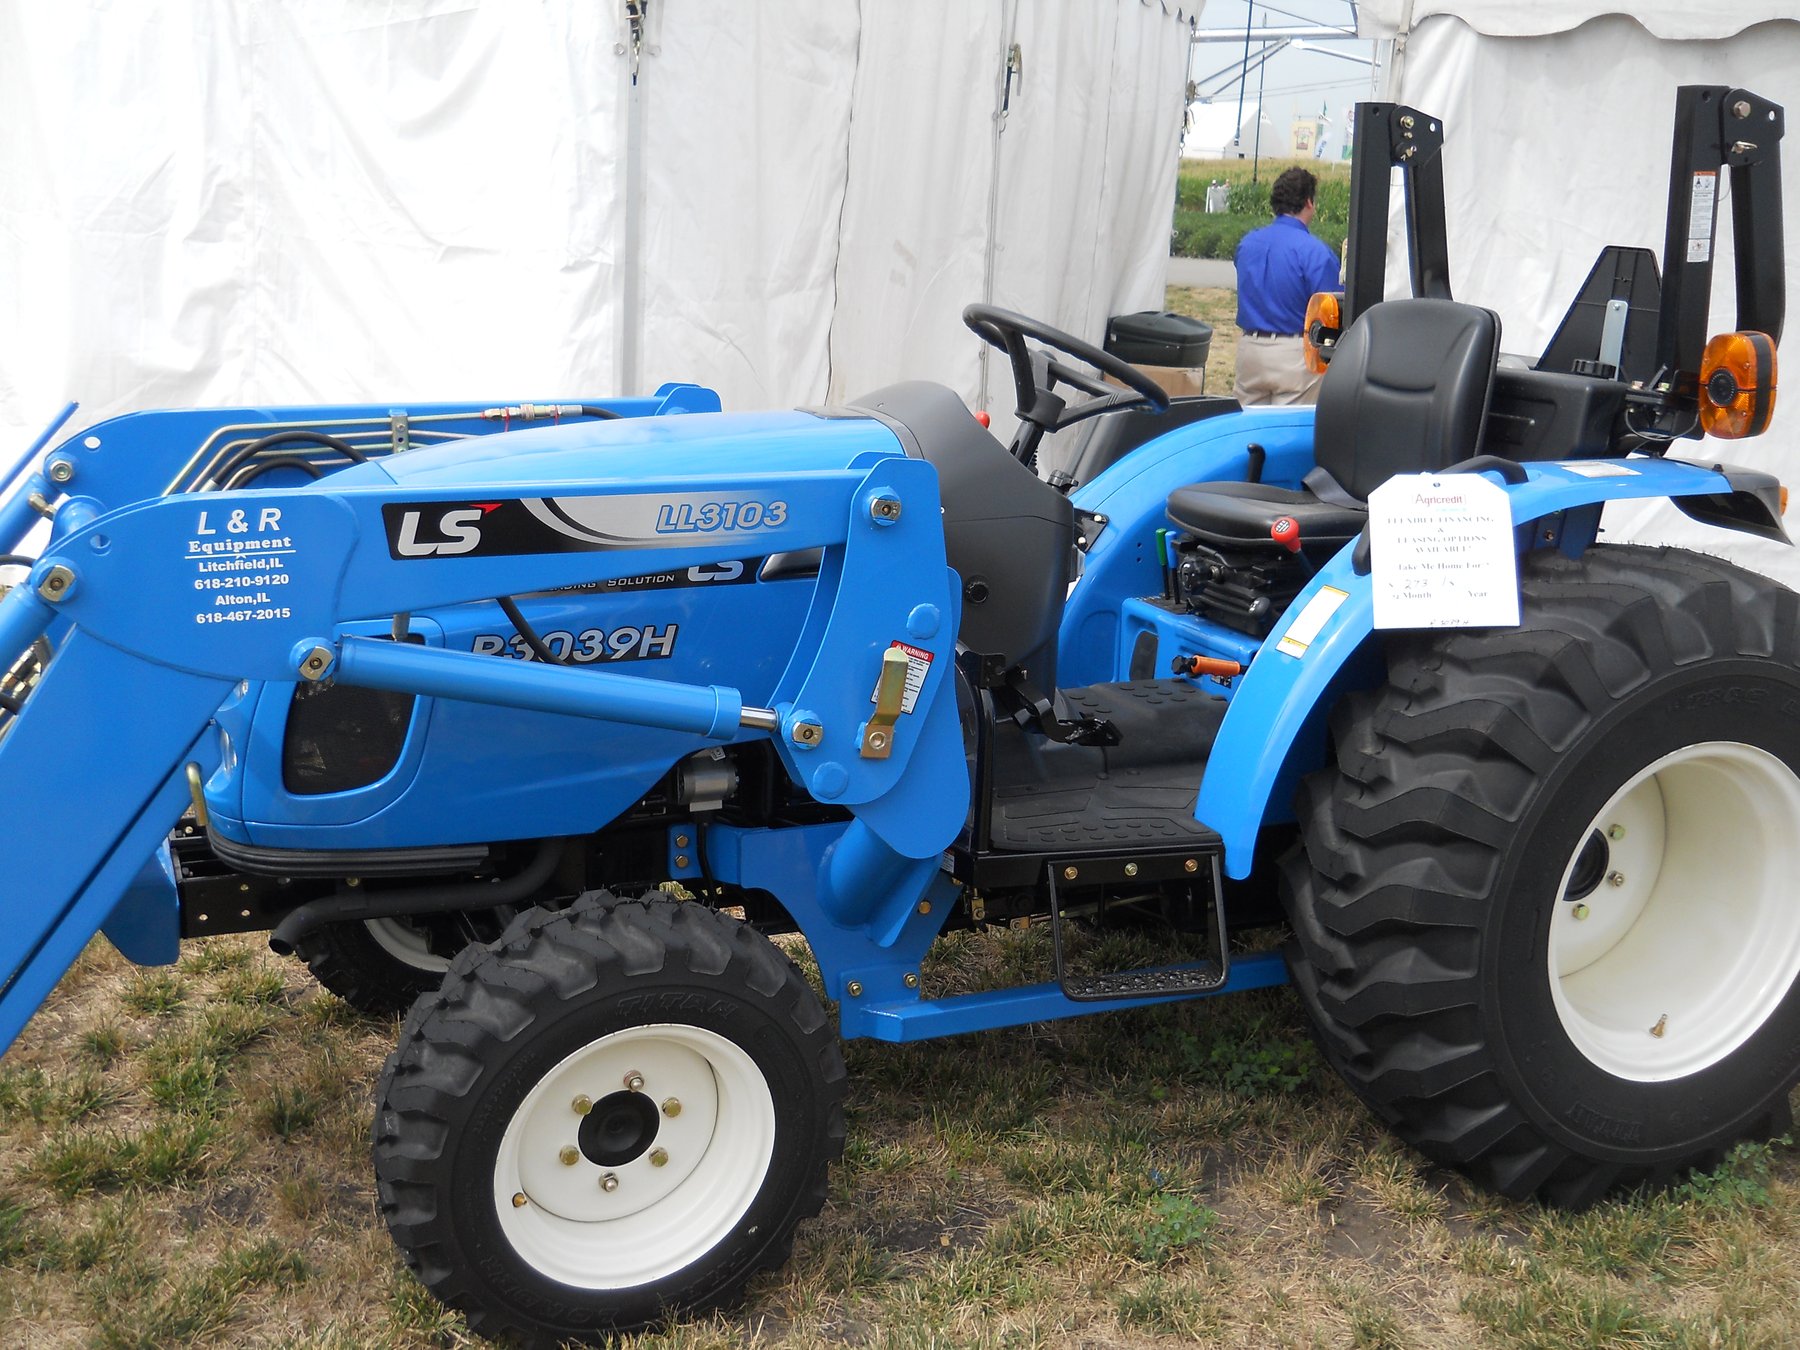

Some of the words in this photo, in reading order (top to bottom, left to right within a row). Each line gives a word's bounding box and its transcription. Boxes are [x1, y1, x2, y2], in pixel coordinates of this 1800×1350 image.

[197, 511, 216, 535] L
[227, 508, 249, 534] &
[259, 507, 281, 532] R
[655, 501, 788, 534] LL3103
[398, 509, 482, 556] LS
[188, 536, 292, 558] Equipment
[198, 558, 284, 573] Litchfield,IL
[194, 574, 289, 590] 618-210-9120
[607, 574, 676, 587] SOLUTION
[215, 592, 271, 606] Alton,IL
[196, 607, 291, 624] 618-467-2015
[902, 645, 929, 660] WARNING
